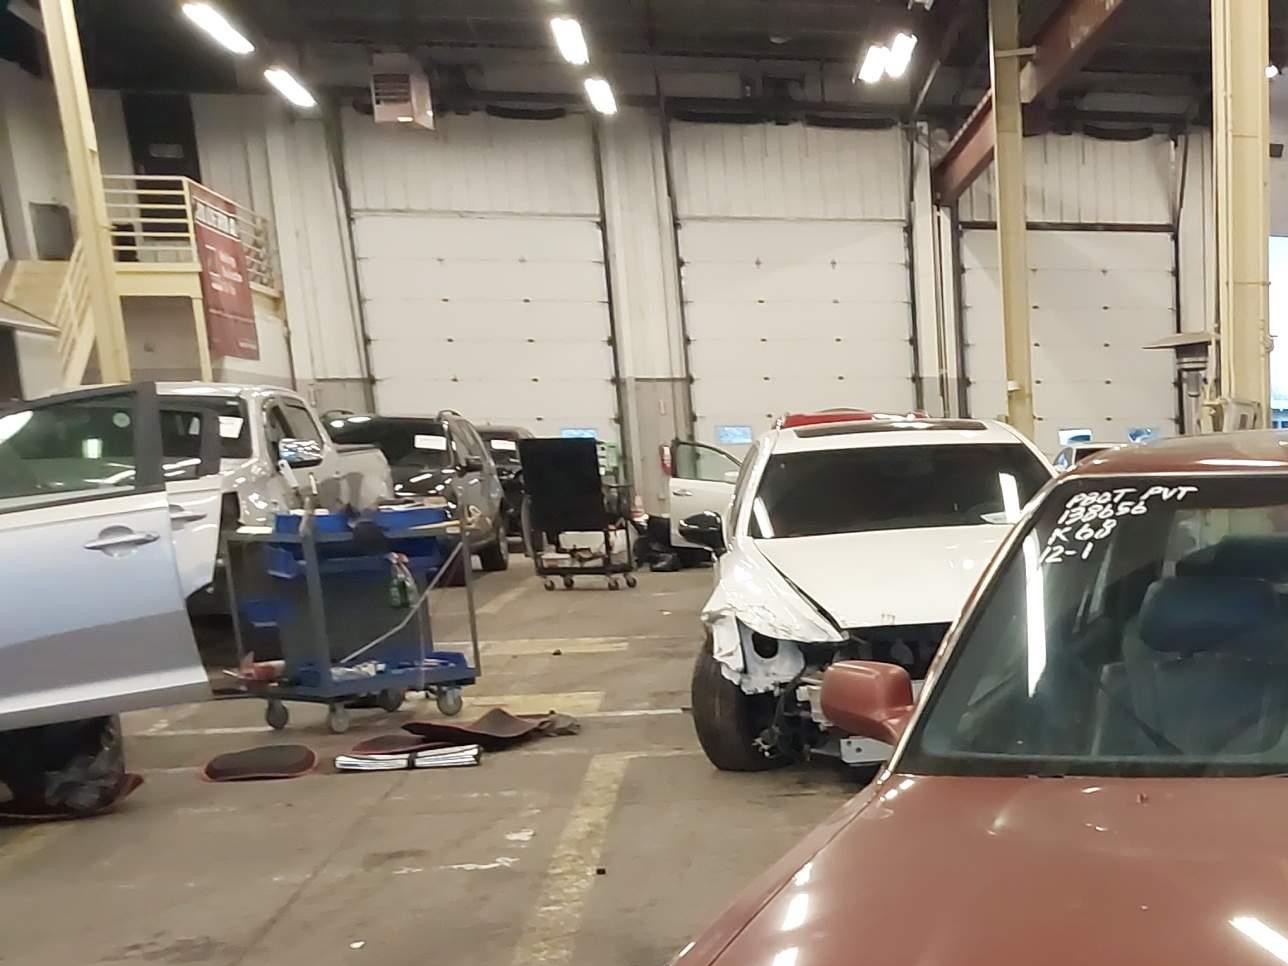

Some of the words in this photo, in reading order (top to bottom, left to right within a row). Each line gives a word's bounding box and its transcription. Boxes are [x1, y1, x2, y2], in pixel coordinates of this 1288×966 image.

[1139, 486, 1199, 500] PVT
[1057, 501, 1148, 525] 138656
[1038, 542, 1093, 563] 12-1
